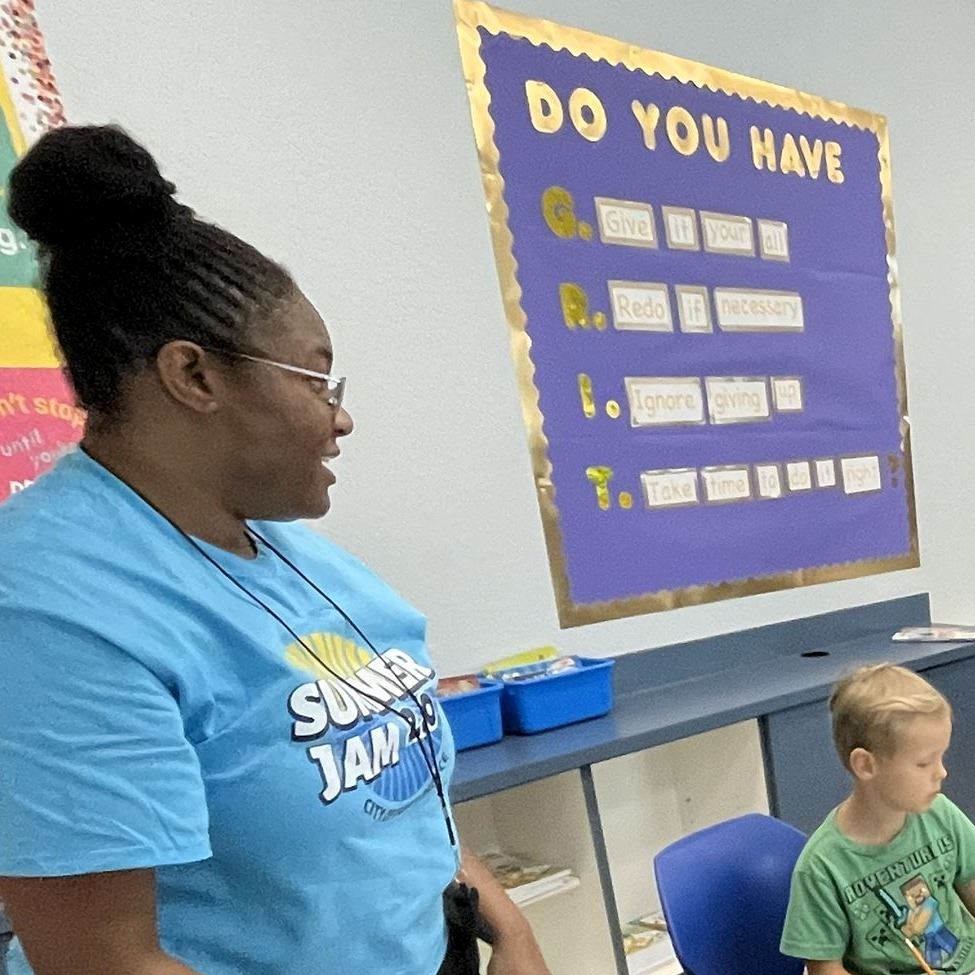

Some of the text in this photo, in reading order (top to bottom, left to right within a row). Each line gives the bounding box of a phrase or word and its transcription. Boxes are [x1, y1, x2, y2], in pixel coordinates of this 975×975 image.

[524, 80, 846, 184] DO YOU HAVE
[605, 210, 649, 236] Give
[673, 218, 690, 234] it
[708, 224, 748, 242] your
[764, 233, 784, 252] all
[616, 294, 665, 320] Redo
[687, 300, 703, 320] if
[634, 388, 697, 420] Ignore
[713, 388, 762, 416] giving
[649, 479, 693, 500] Take
[710, 473, 746, 494] time
[790, 466, 809, 486] do
[287, 648, 436, 741] SUMMER
[305, 722, 400, 806] JAM
